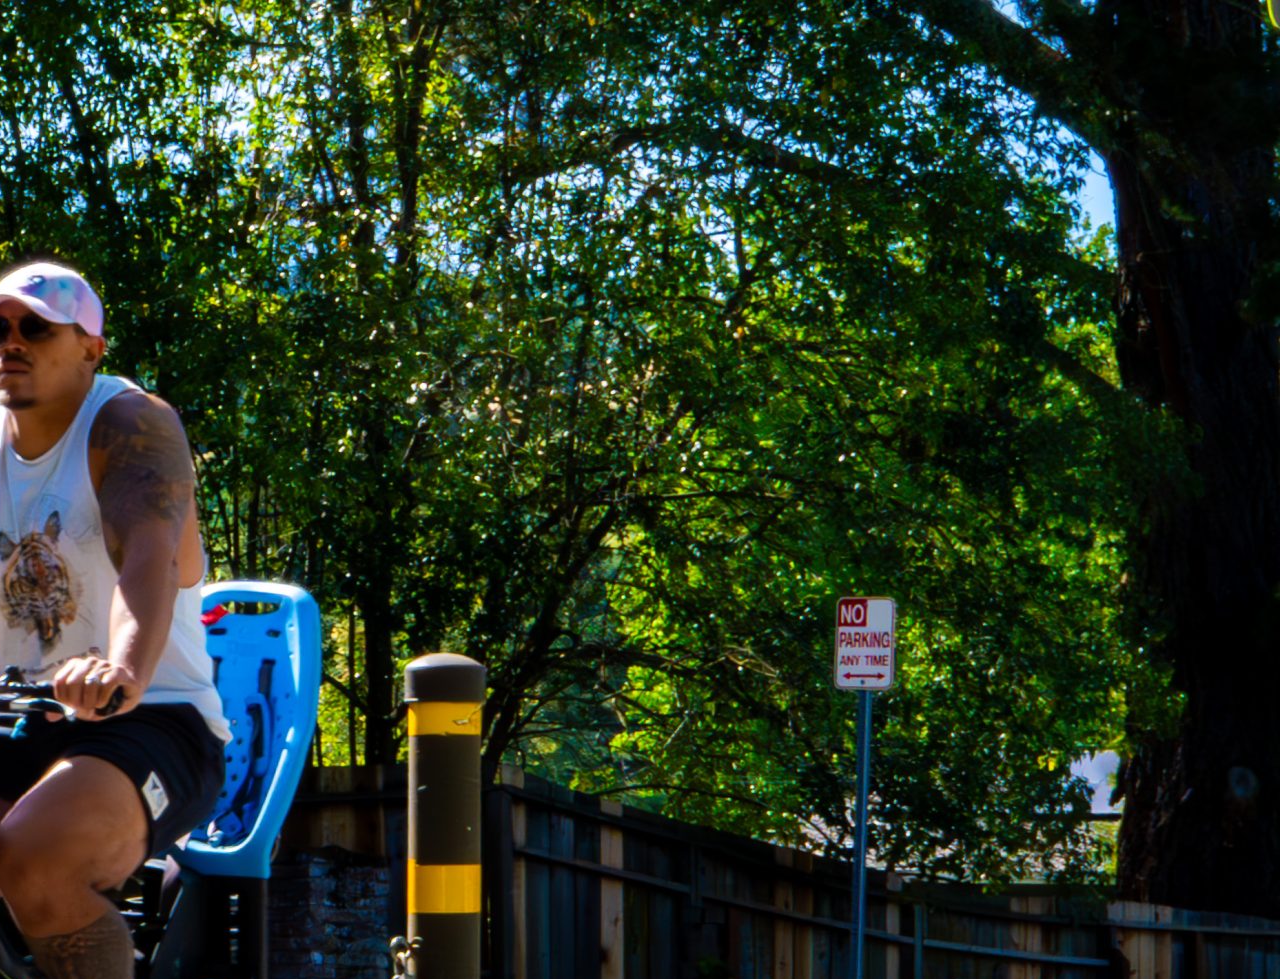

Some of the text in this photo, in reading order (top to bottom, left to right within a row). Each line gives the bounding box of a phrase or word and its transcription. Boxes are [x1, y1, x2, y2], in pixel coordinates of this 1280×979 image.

[840, 604, 865, 624] NO
[839, 632, 890, 648] PARKING
[840, 655, 889, 666] ANY TIME
